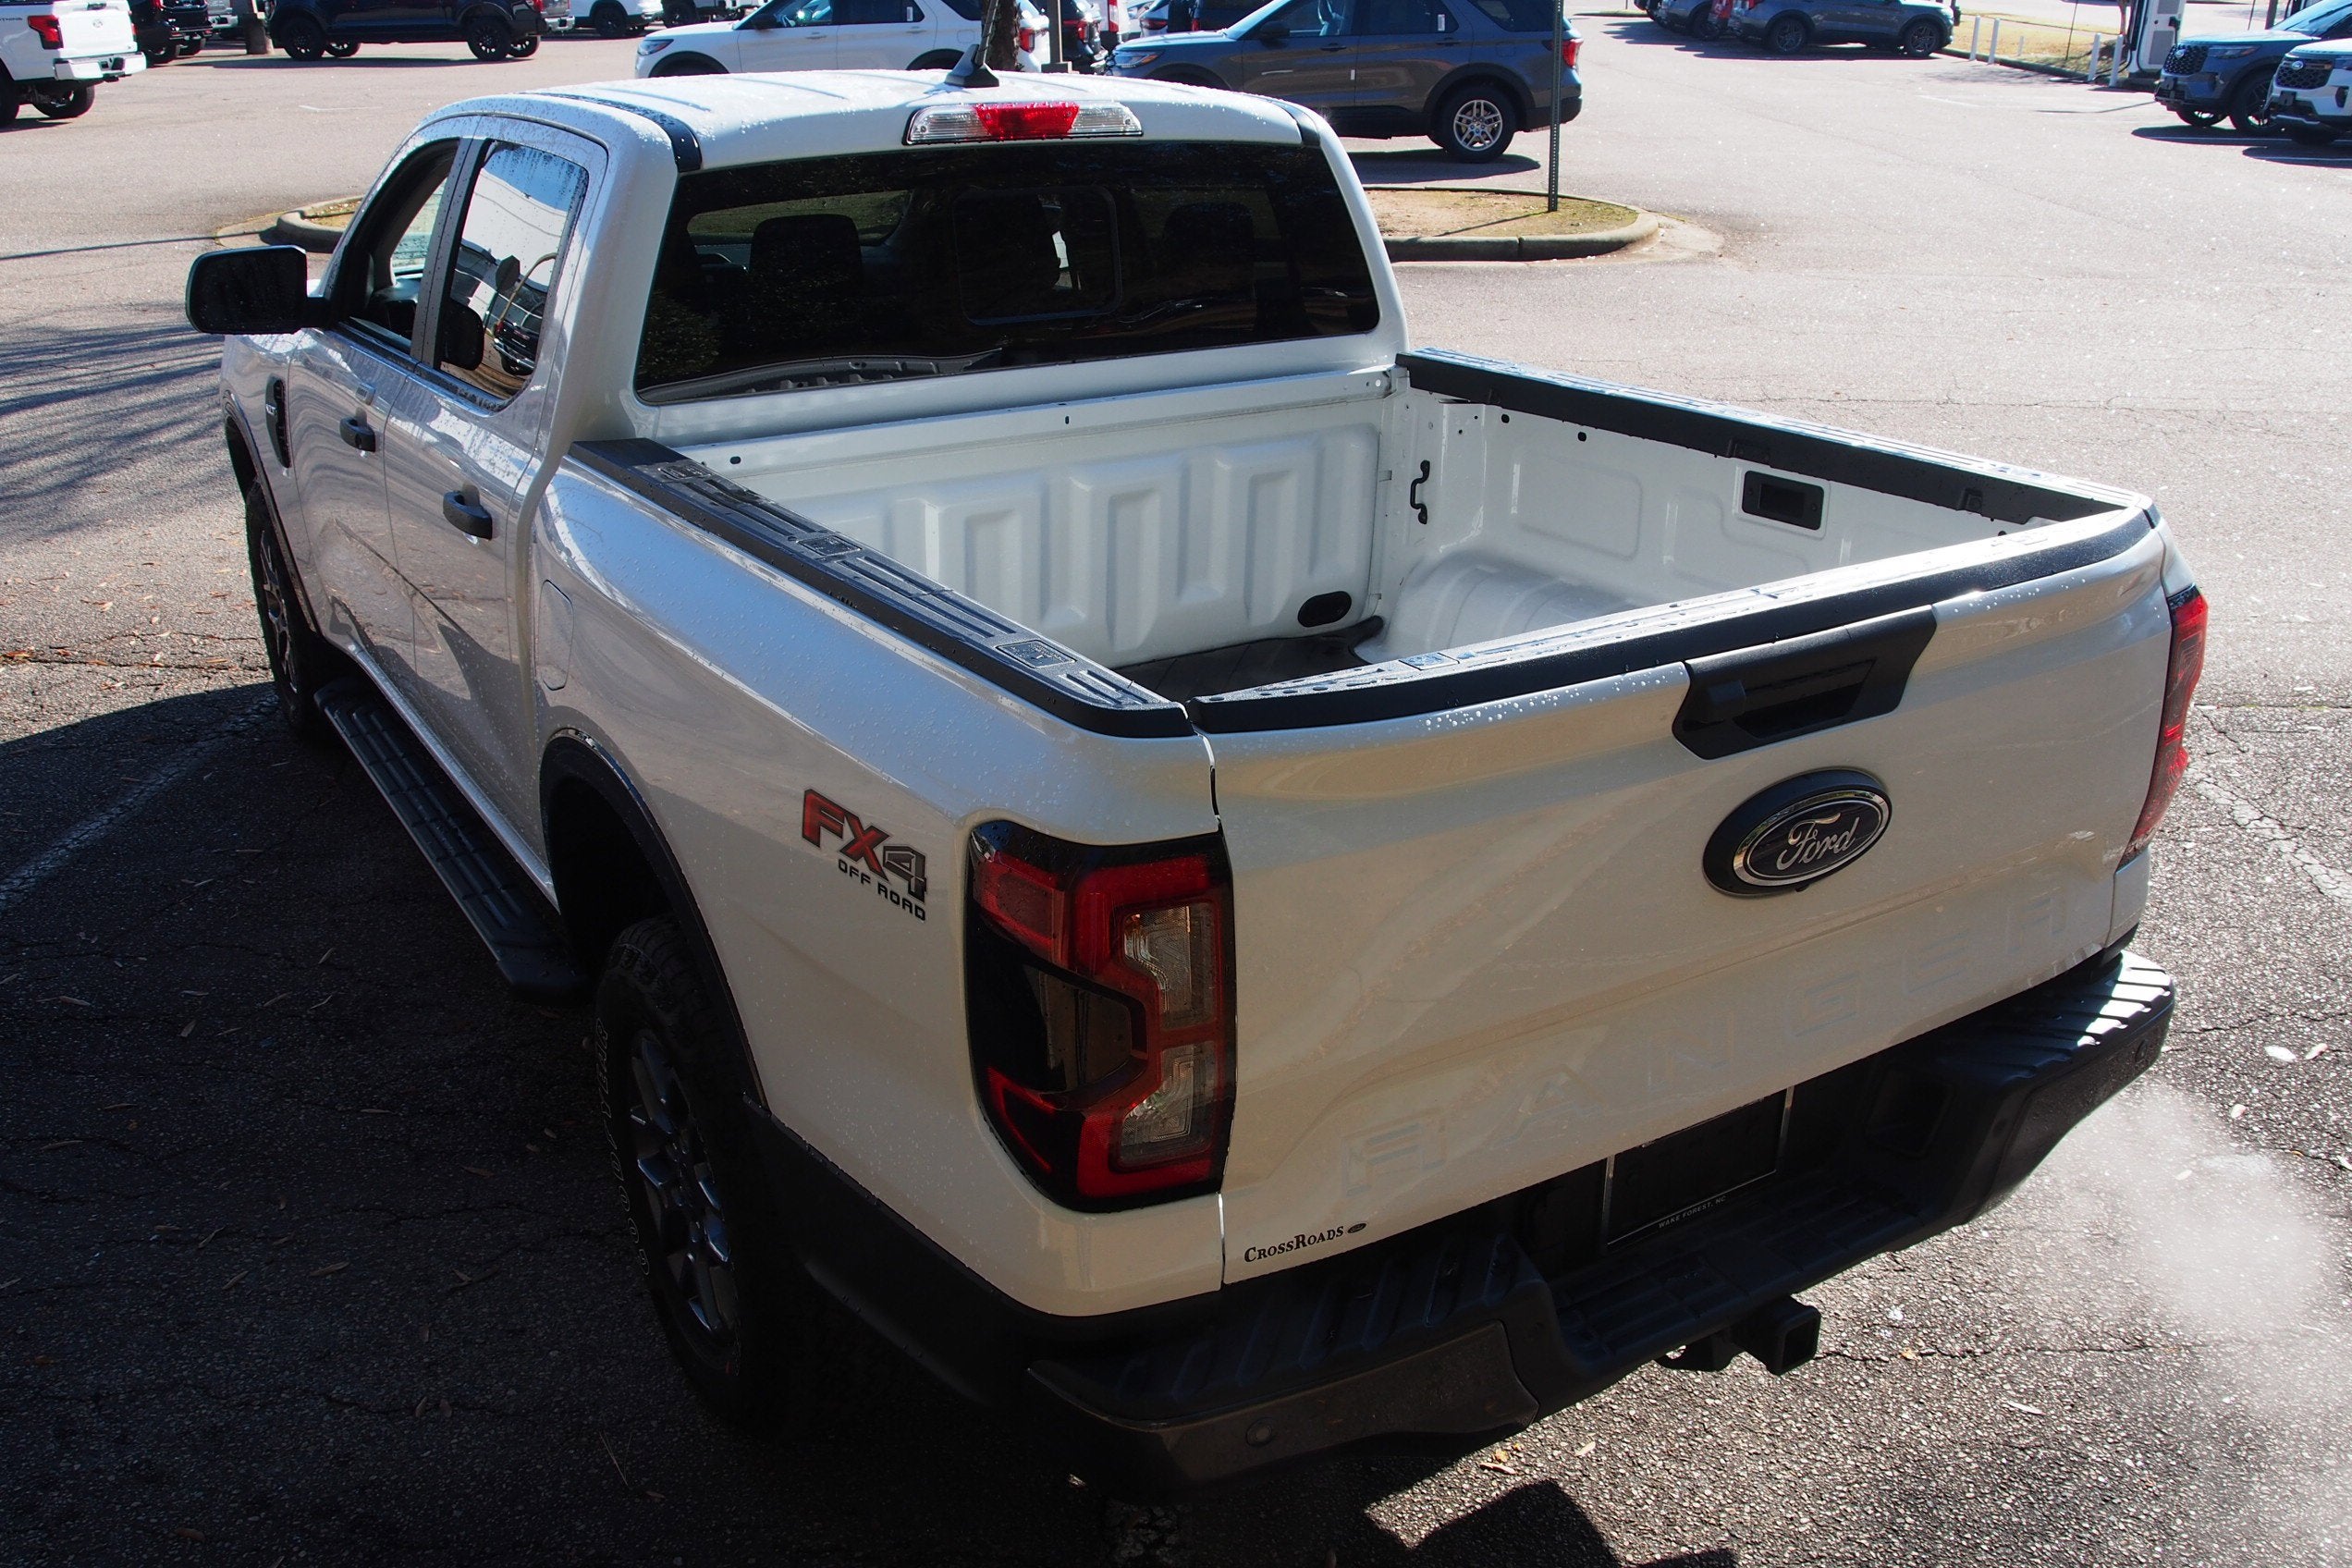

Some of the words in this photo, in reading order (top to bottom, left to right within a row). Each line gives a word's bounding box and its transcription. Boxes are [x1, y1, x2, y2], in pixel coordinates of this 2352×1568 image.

[802, 789, 927, 902] FX4
[1776, 813, 1860, 871] Ford
[838, 859, 871, 885] OFF
[877, 881, 926, 922] ROAD
[1342, 886, 2067, 1196] RANGER
[1658, 1215, 1681, 1229] WAKE
[1715, 1194, 1727, 1205] NC
